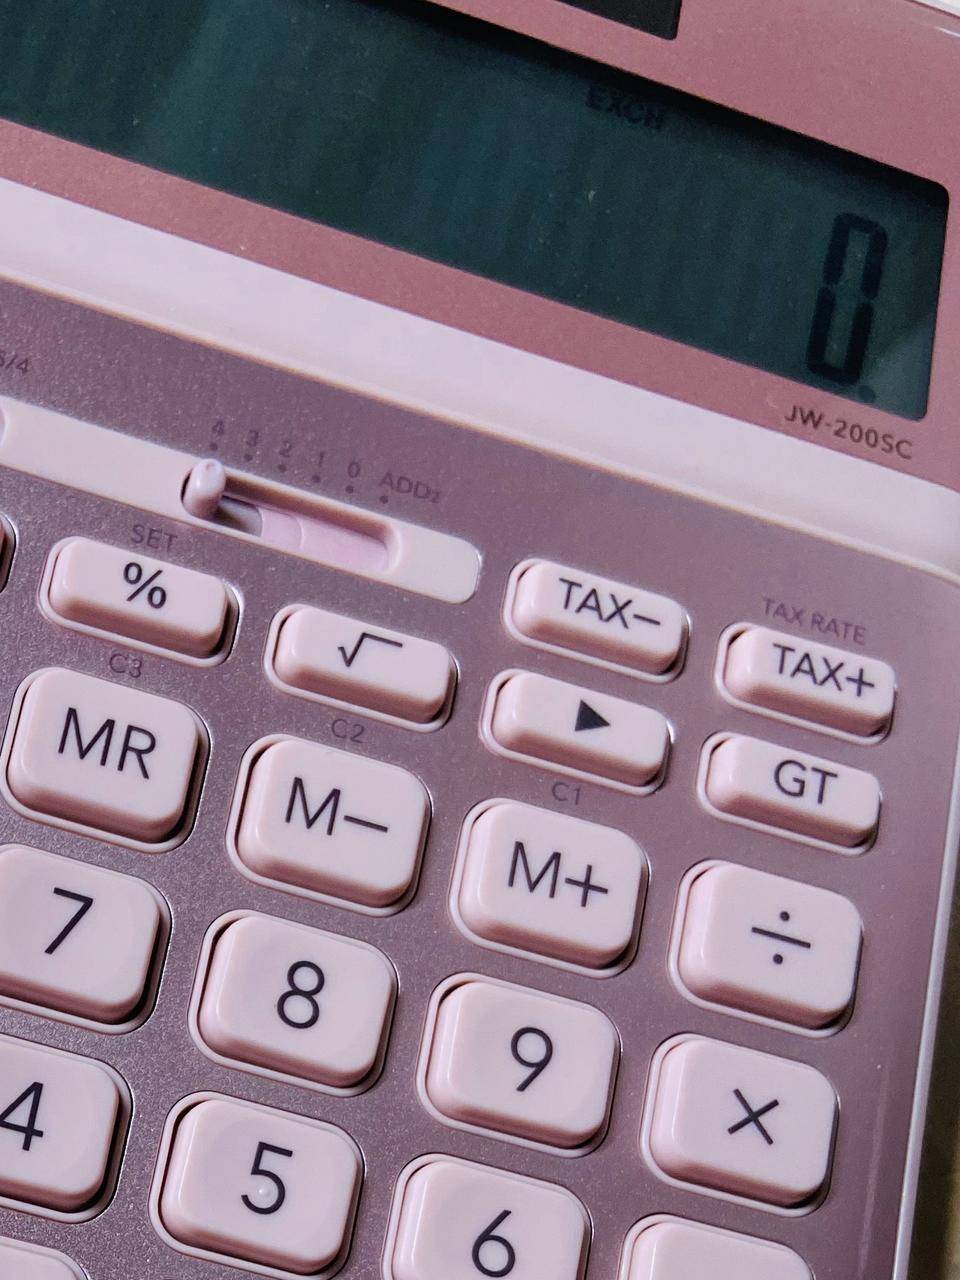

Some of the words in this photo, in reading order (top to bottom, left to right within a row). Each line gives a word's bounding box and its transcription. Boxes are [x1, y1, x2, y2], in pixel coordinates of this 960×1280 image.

[211, 421, 225, 436] 4
[246, 429, 259, 447] 3
[279, 440, 292, 458] 2
[784, 404, 913, 460] JW-200SC
[130, 524, 178, 553] SET
[123, 562, 167, 609] %
[761, 596, 804, 627] TAX
[809, 611, 867, 646] RATE
[108, 652, 142, 678] C3
[772, 643, 875, 698] TAX+
[57, 707, 157, 780] MR
[331, 718, 365, 744] C2
[551, 781, 581, 806] C1
[773, 759, 838, 804] GT
[508, 841, 609, 908] M+
[44, 887, 94, 955] 7
[276, 960, 325, 1030] 8
[510, 1026, 554, 1092] 9
[240, 1141, 294, 1216] 5
[471, 1209, 516, 1279] 6
